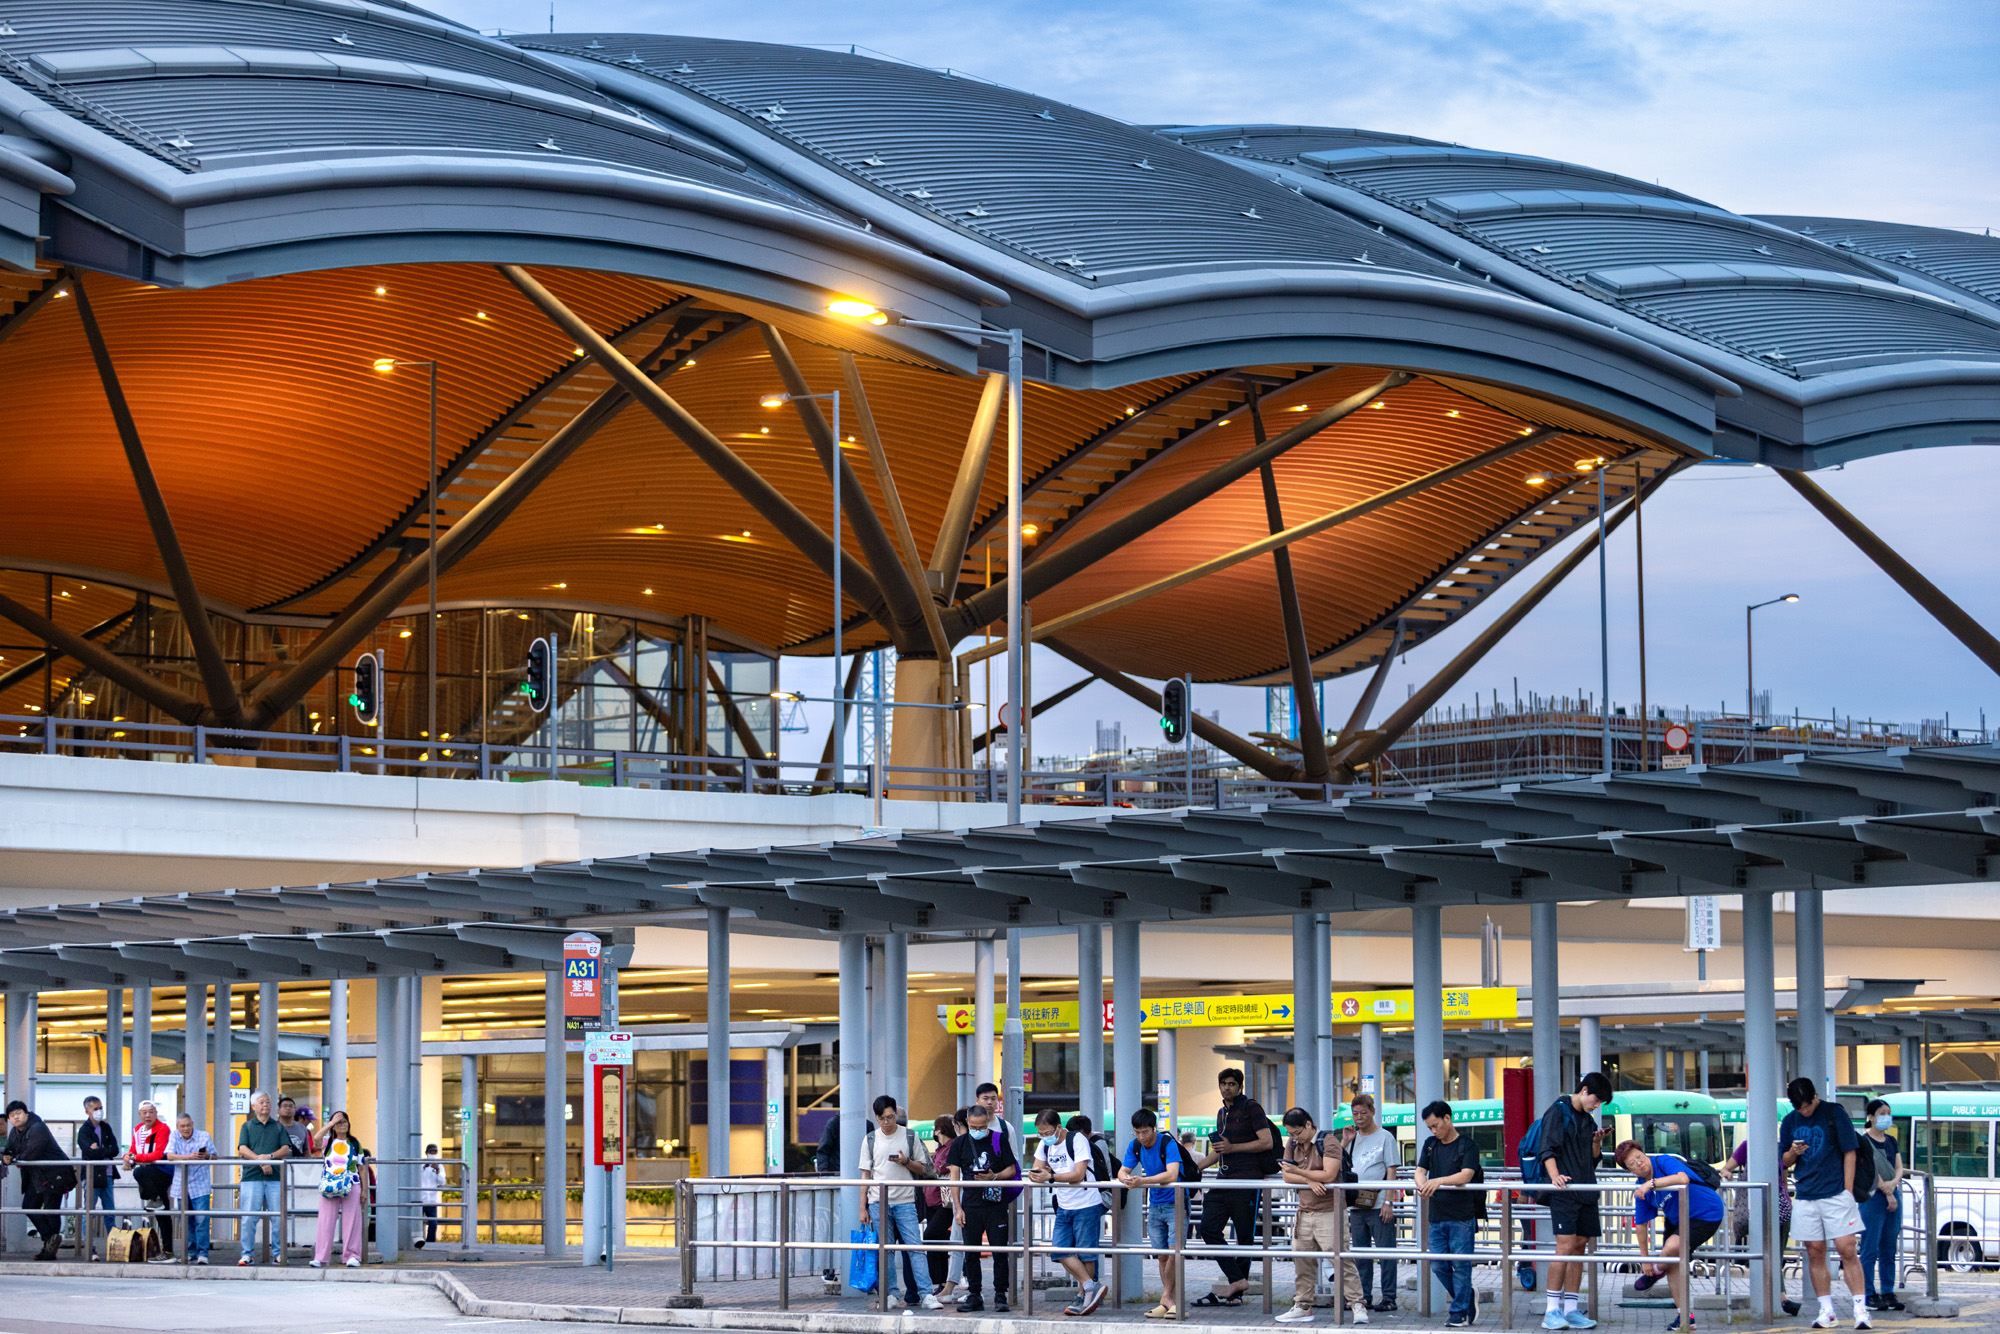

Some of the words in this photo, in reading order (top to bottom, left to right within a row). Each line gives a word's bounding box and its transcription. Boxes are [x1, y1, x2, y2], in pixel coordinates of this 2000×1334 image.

[589, 946, 598, 954] E2
[567, 960, 596, 977] A31
[572, 979, 593, 992] 荃灣
[1446, 992, 1469, 1007] 荃灣
[1151, 1001, 1205, 1017] 迪士尼樂園
[566, 1021, 580, 1030] NA31
[1163, 1018, 1192, 1026] Disneyland
[1454, 1110, 1503, 1120] 公共小型巴士
[1952, 1105, 1977, 1115] PUBLIC
[1382, 1115, 1398, 1124] LIGHT
[1403, 1114, 1415, 1123] BUS
